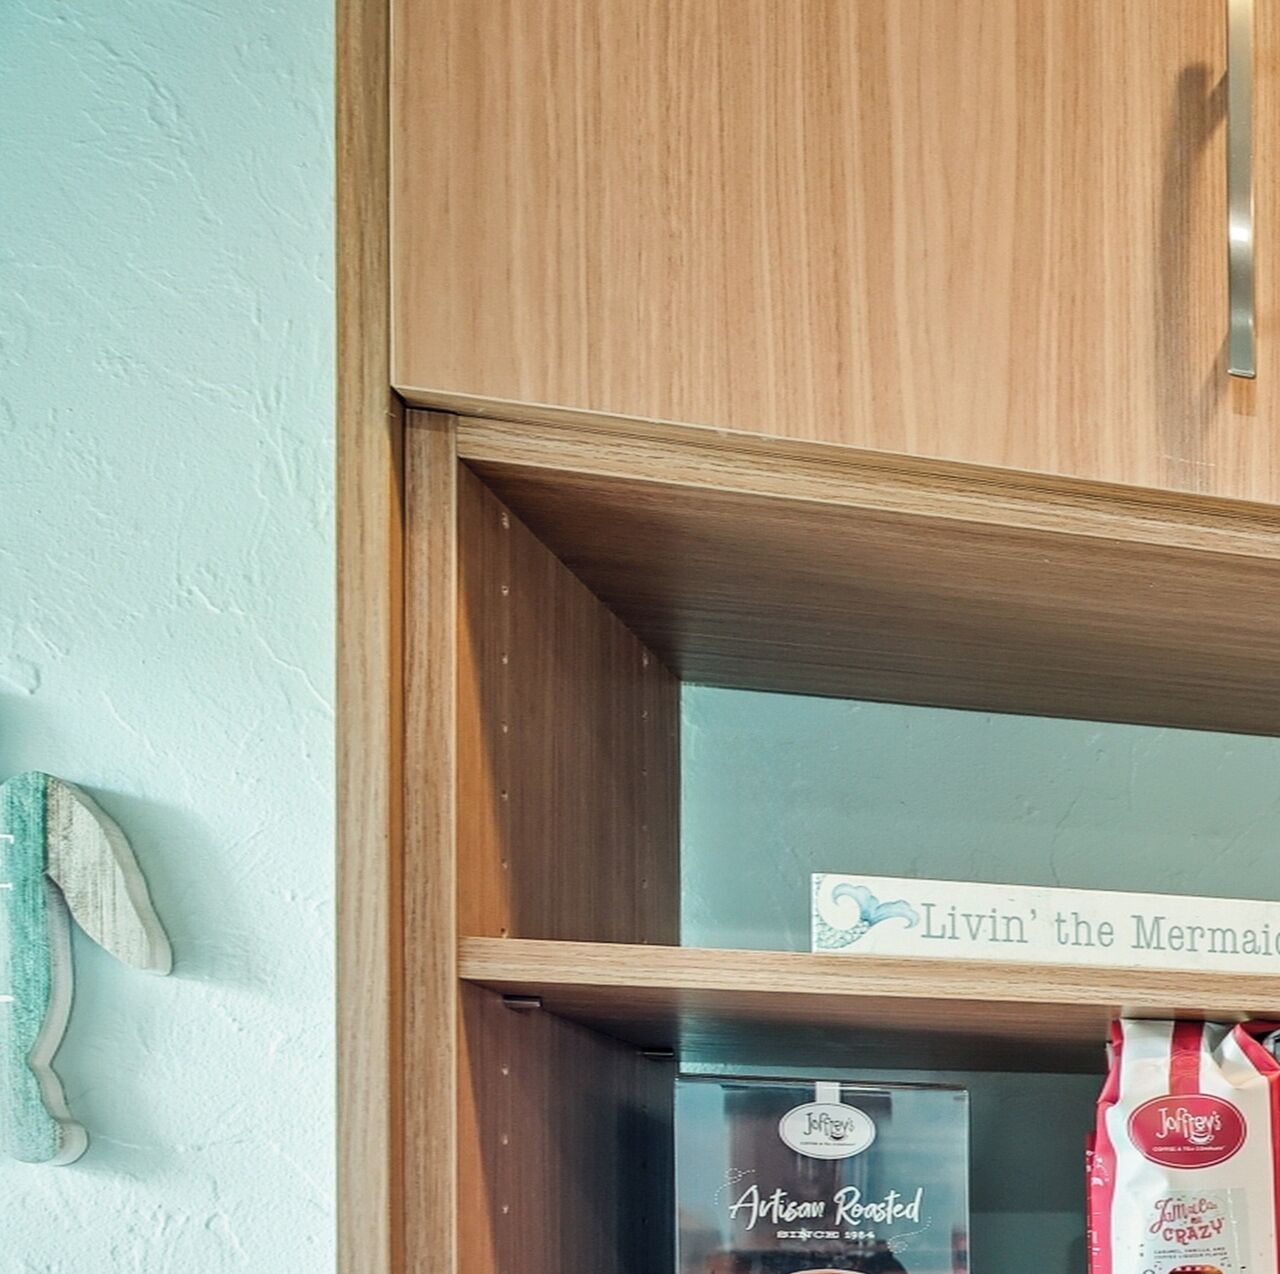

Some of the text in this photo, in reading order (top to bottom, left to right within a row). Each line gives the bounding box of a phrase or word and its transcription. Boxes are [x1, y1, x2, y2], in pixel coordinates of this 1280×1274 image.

[1055, 911, 1115, 947] the
[729, 1184, 923, 1231] Artisan Roasted
[776, 1229, 840, 1240] SINCE
